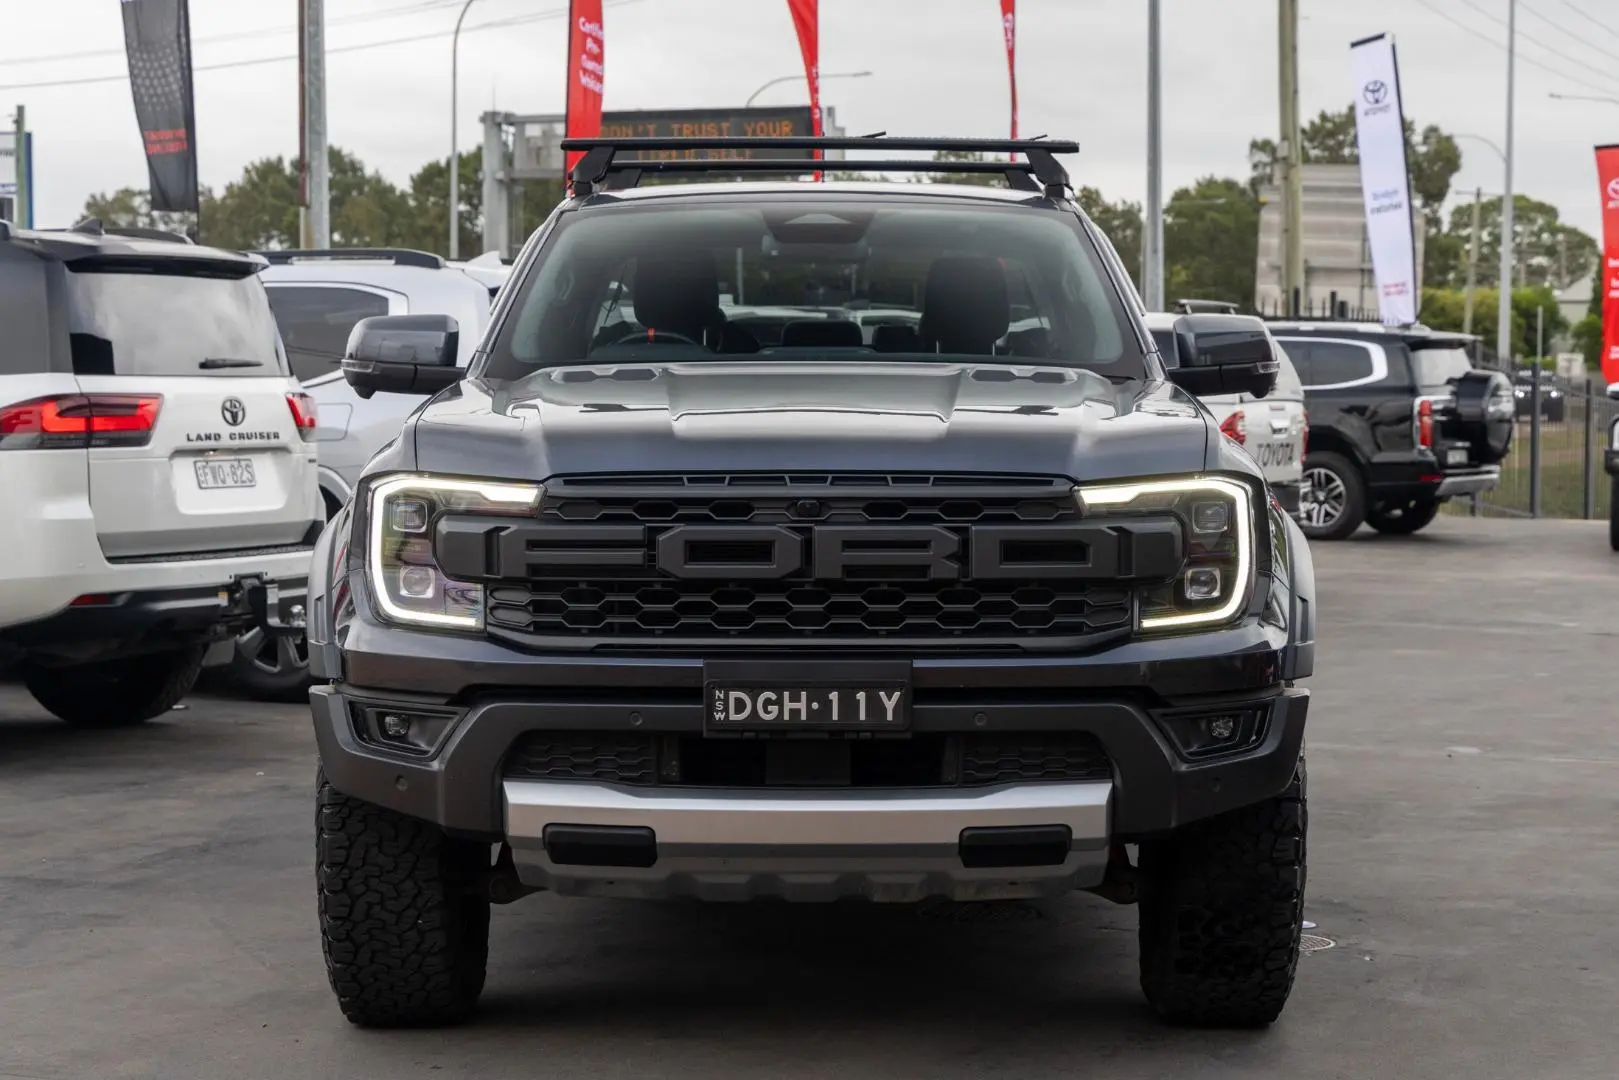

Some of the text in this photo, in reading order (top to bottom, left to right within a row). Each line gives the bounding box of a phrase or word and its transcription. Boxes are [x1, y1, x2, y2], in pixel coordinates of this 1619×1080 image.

[671, 121, 731, 138] TRUST
[744, 119, 793, 138] YOUR
[186, 431, 280, 442] LAND CRUISER
[1257, 442, 1294, 467] TOYOTA
[498, 524, 1119, 580] FORD
